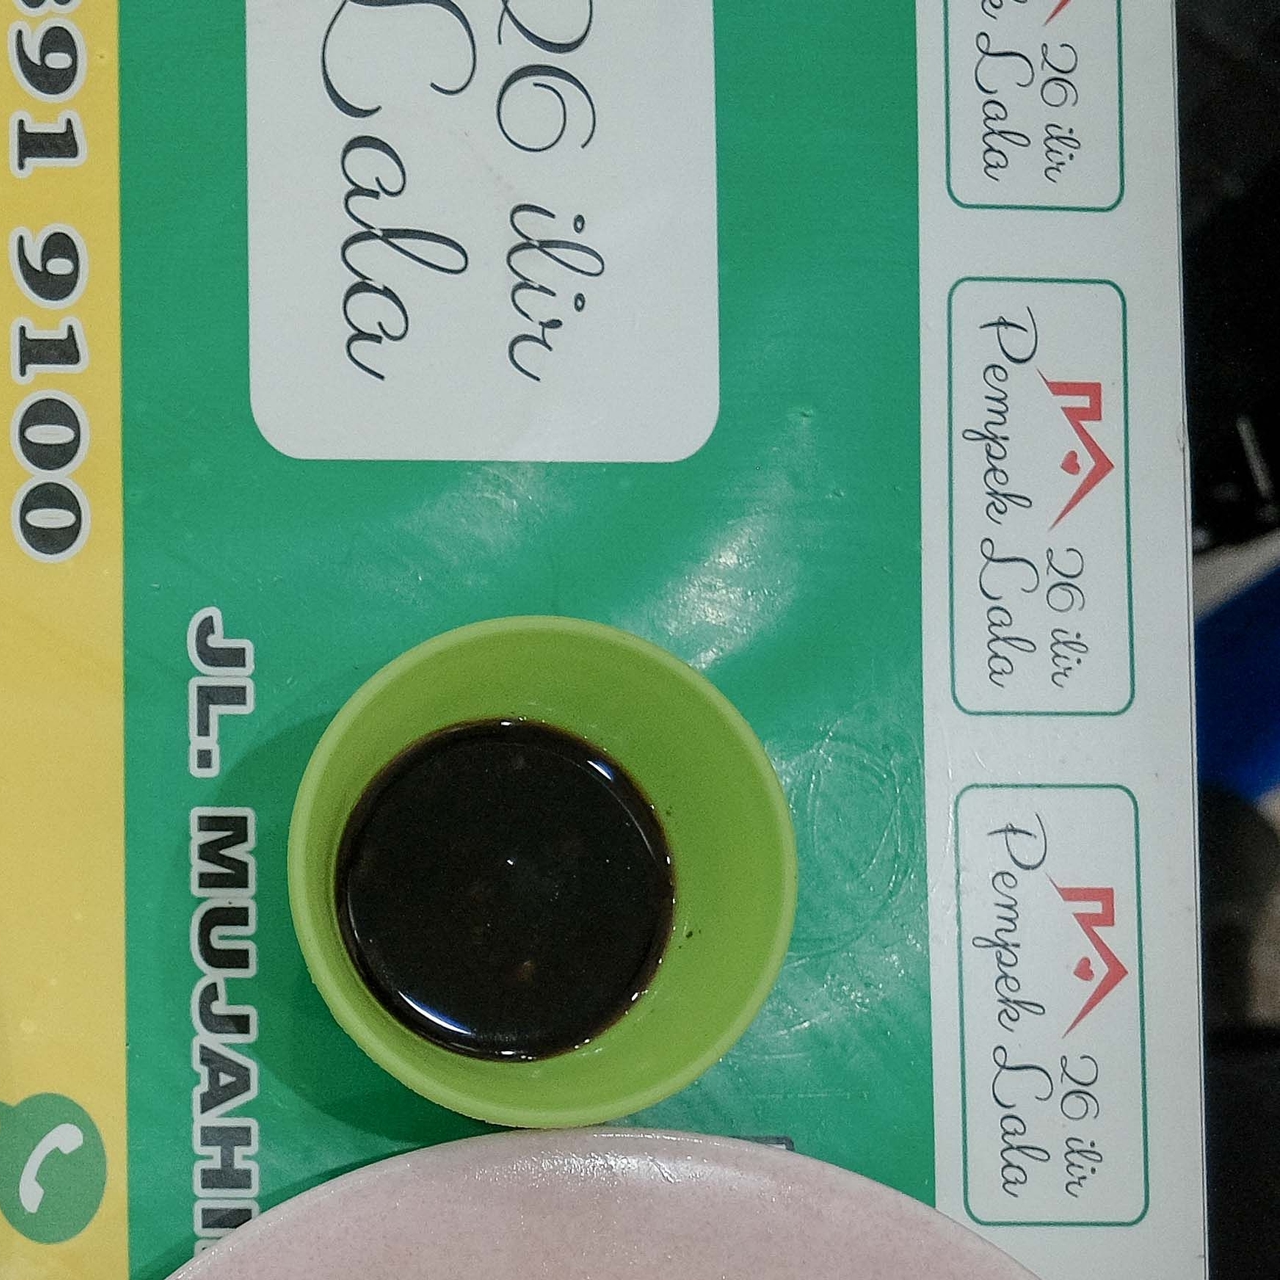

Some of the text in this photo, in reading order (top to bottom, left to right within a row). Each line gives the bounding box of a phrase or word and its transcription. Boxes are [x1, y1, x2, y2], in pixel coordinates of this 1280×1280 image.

[974, 31, 1036, 182] Lala
[1040, 42, 1082, 184] 26 ilir
[15, 0, 83, 557] 91 9100
[505, 203, 606, 383] ilir
[961, 305, 1040, 689] Pempek Lala
[1045, 547, 1089, 689] 26 ilir
[196, 615, 253, 1256] JL. MUJAHI
[971, 812, 1054, 1198] Pempek Lala
[1060, 1054, 1104, 1199] 26 ilir
